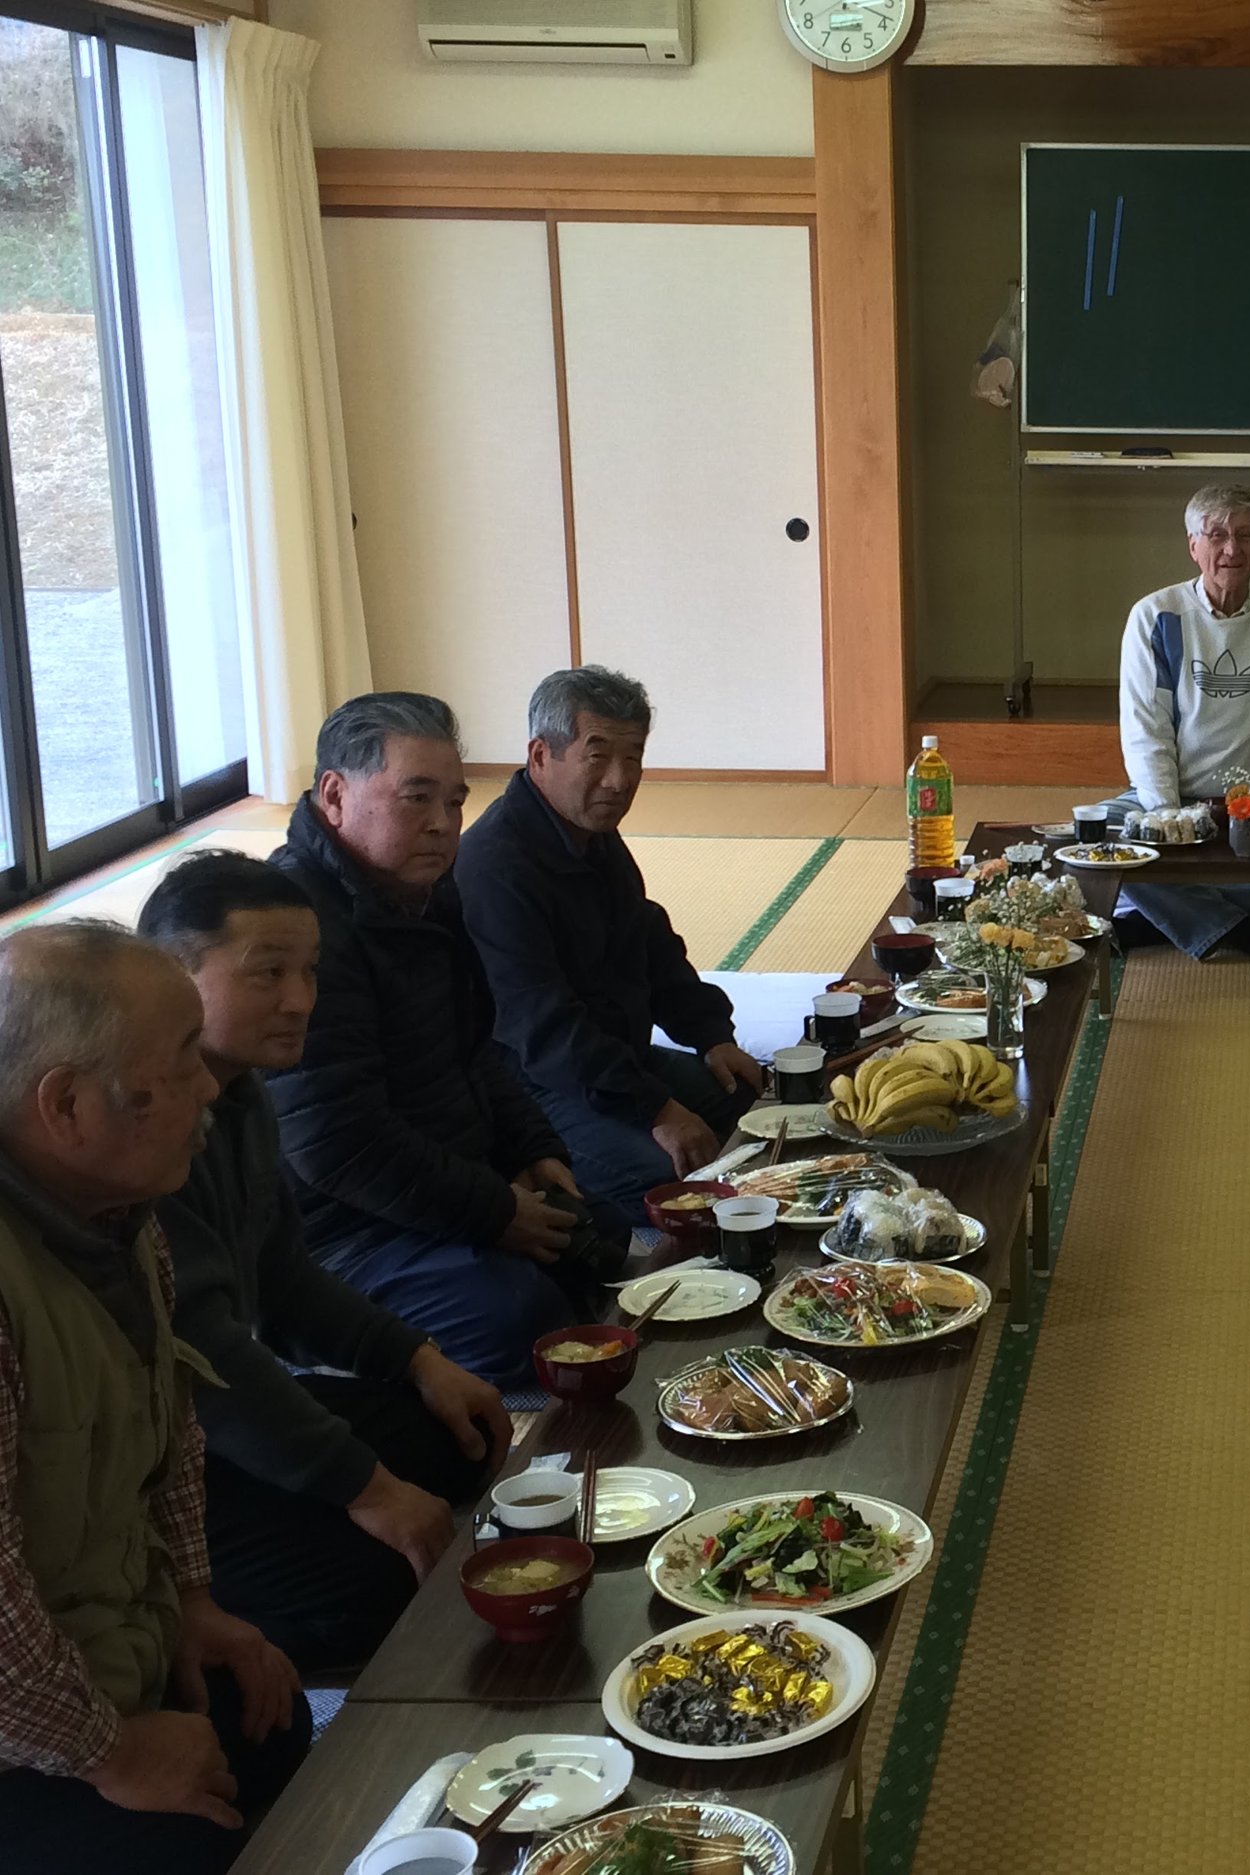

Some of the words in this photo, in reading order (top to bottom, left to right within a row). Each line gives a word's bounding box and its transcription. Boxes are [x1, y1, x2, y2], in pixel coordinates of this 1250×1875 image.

[804, 12, 814, 30] 8
[877, 15, 888, 32] 4
[820, 31, 831, 48] 7
[841, 37, 852, 54] 6
[863, 32, 874, 50] 5
